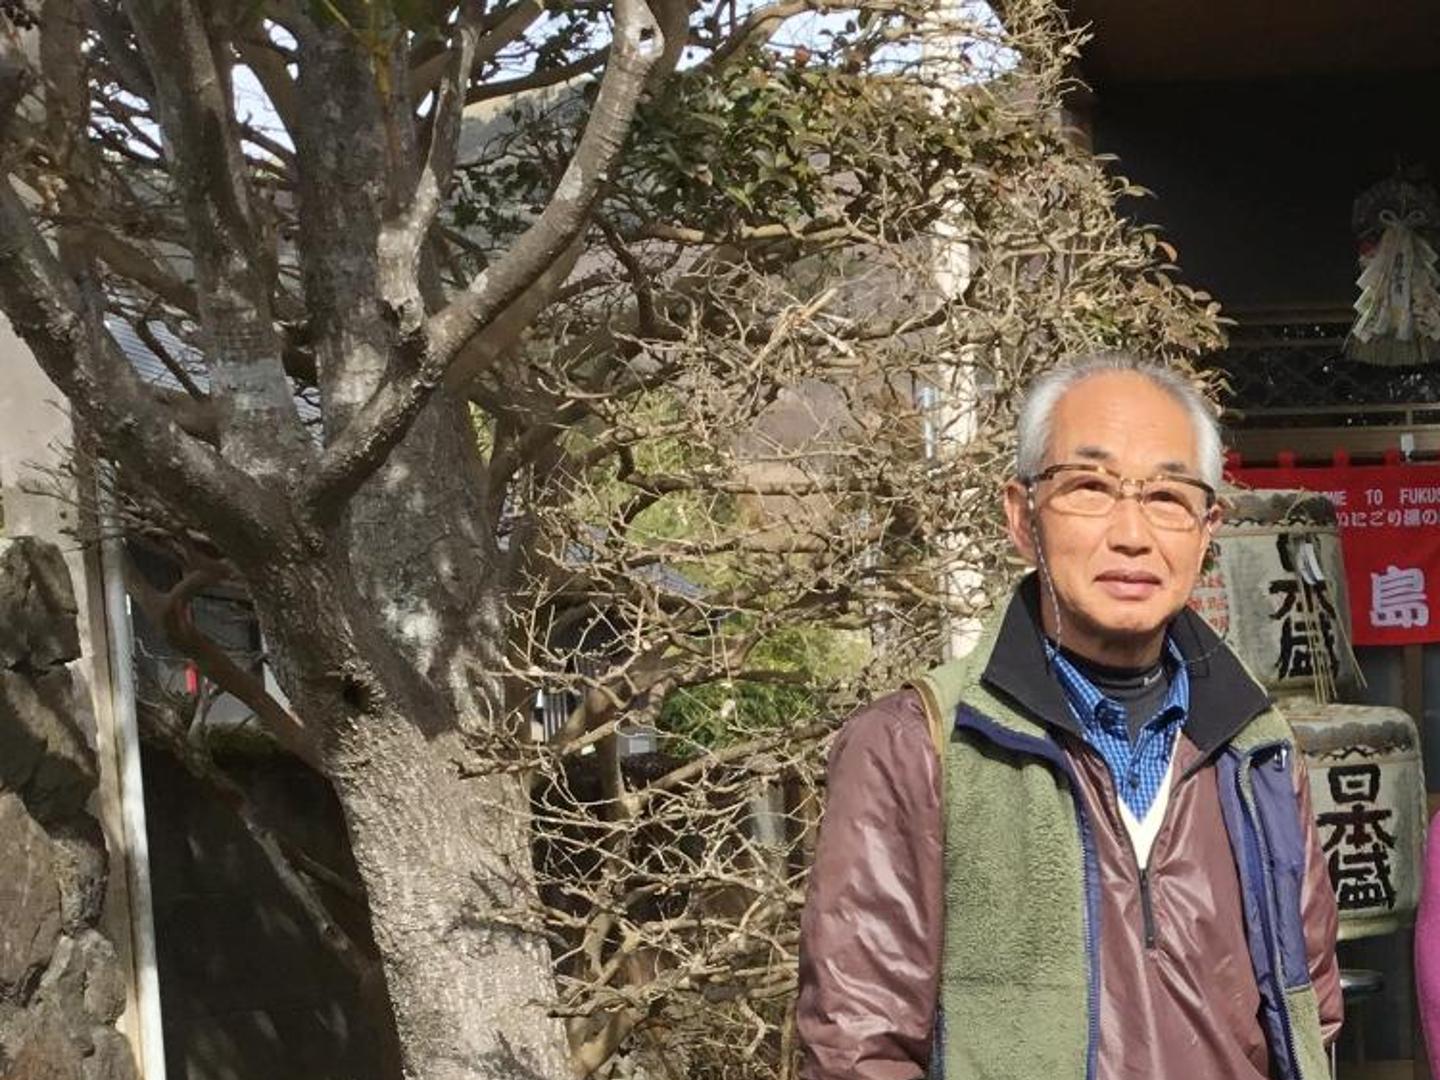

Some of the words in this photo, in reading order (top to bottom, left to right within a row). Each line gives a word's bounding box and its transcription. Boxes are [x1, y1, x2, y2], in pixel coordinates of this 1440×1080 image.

[1365, 488, 1383, 506] TO
[1316, 763, 1397, 911] 日本盛
